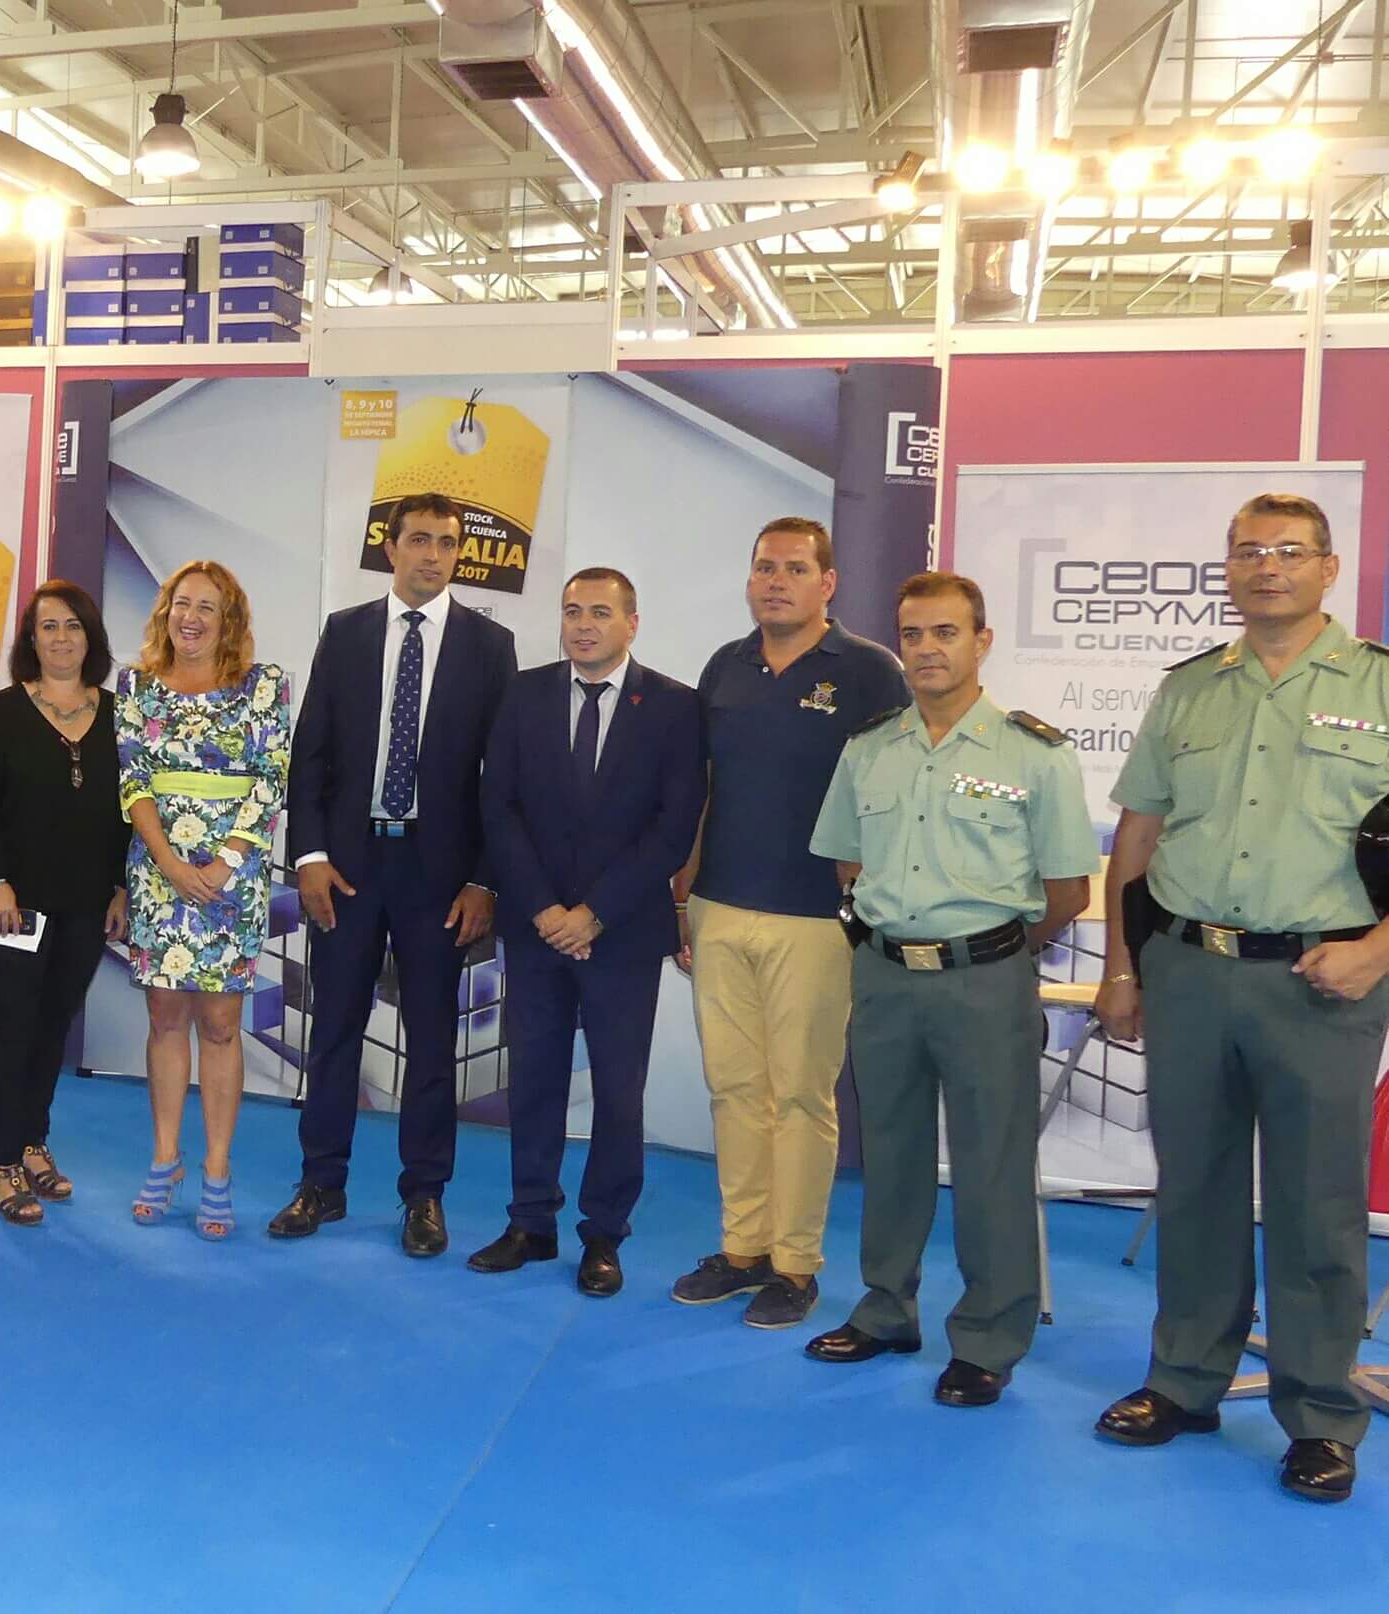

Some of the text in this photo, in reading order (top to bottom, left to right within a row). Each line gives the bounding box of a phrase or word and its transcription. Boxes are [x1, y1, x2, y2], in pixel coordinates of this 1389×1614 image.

[378, 400, 393, 409] 10
[464, 512, 494, 525] STOCK
[471, 526, 507, 539] CUENCA
[456, 565, 490, 581] 2017
[1052, 599, 1244, 626] CEPYME
[1074, 633, 1215, 652] CUENCA
[1060, 681, 1084, 710] Al
